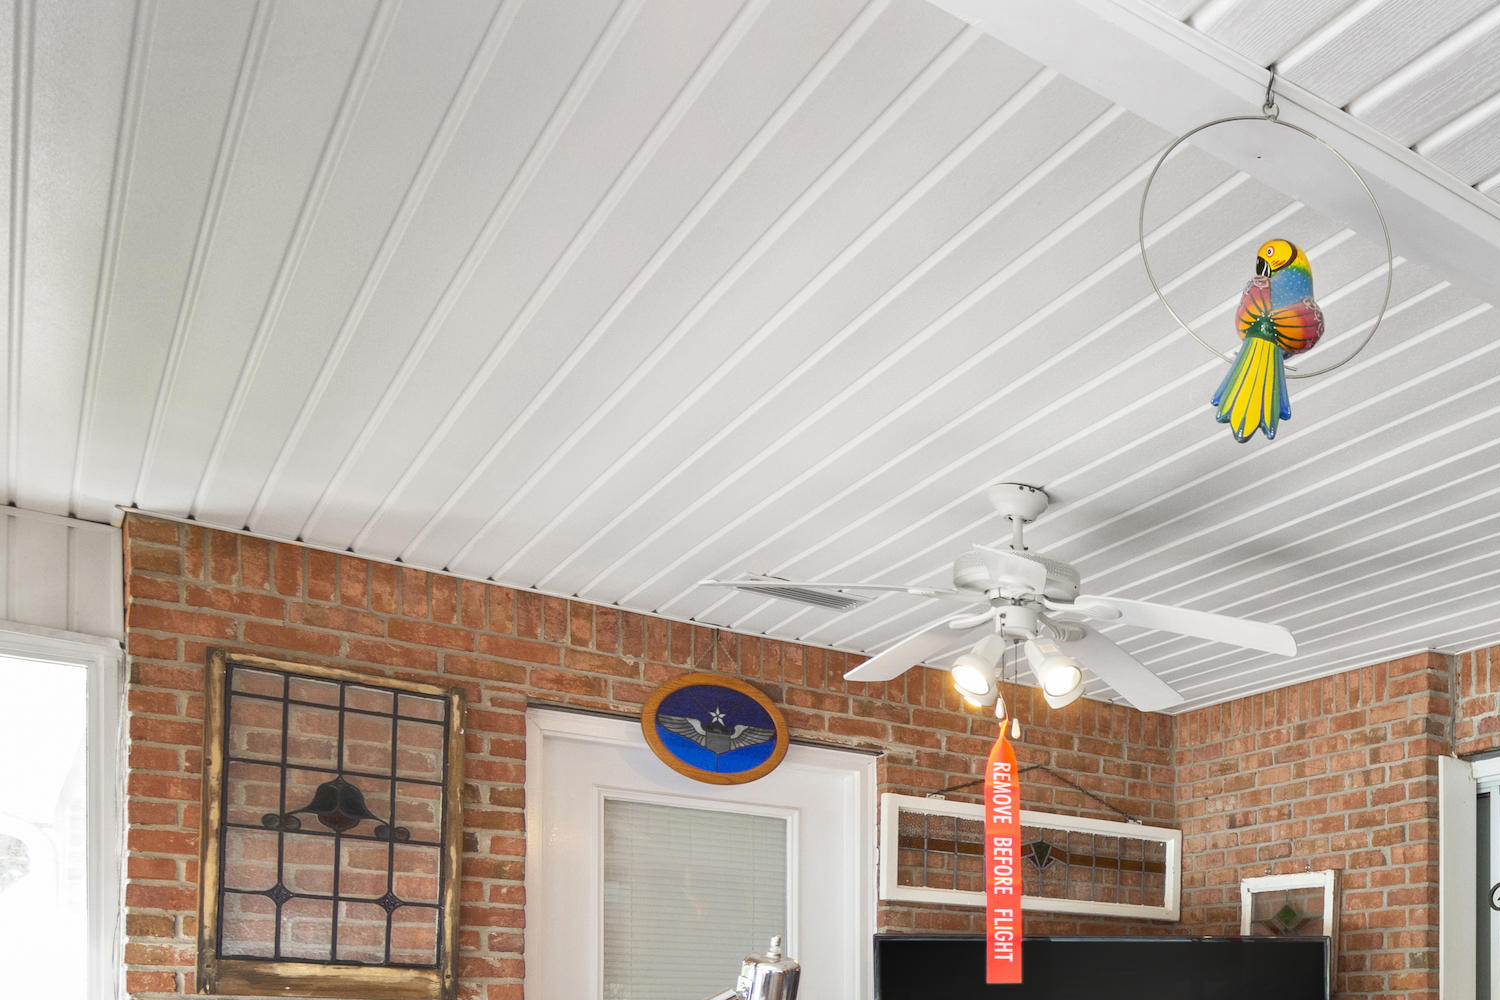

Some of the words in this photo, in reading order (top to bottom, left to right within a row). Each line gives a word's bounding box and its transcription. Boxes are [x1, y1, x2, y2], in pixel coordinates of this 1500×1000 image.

[992, 762, 1012, 825] REMOVE
[993, 837, 1013, 895] BEFORE
[994, 908, 1014, 962] FLIGHT
